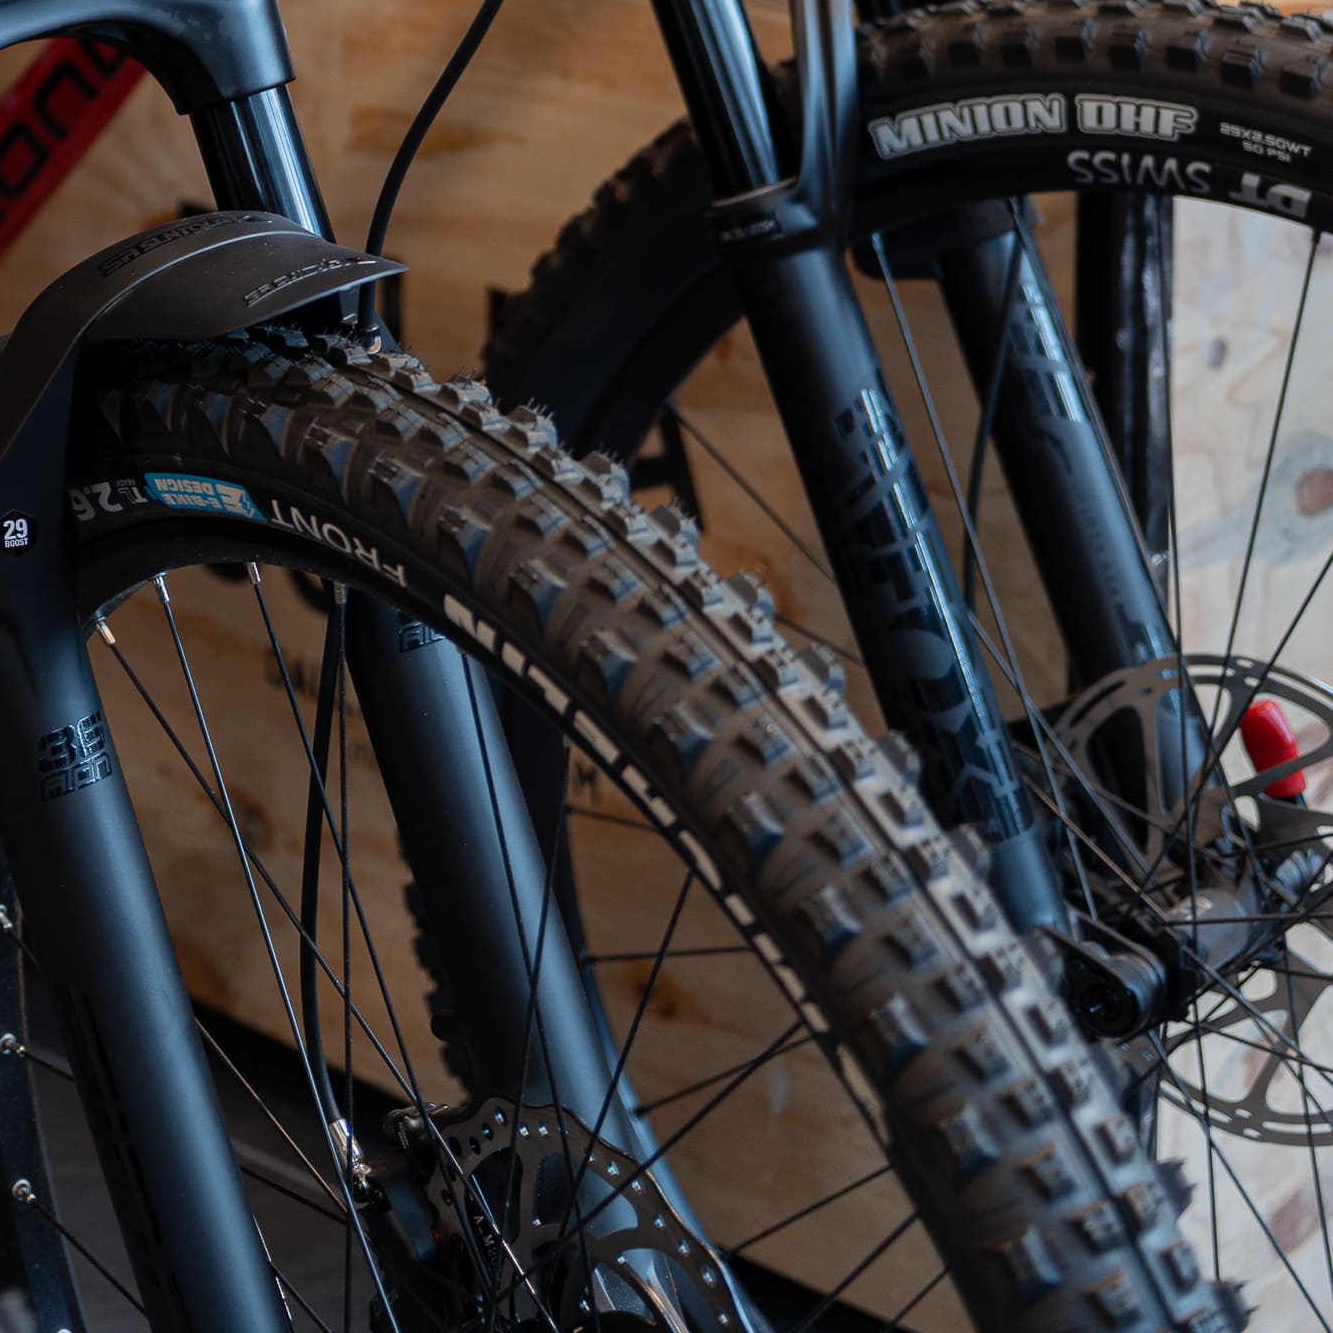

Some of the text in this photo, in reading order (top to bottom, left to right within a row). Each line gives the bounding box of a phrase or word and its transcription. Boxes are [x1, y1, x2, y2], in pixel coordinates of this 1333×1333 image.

[869, 92, 1199, 160] MINION DHF
[1067, 149, 1211, 194] SWISS
[152, 477, 216, 495] DESIGN
[3, 518, 29, 540] 29
[4, 537, 29, 548] BOOST
[270, 498, 408, 589] FRONT
